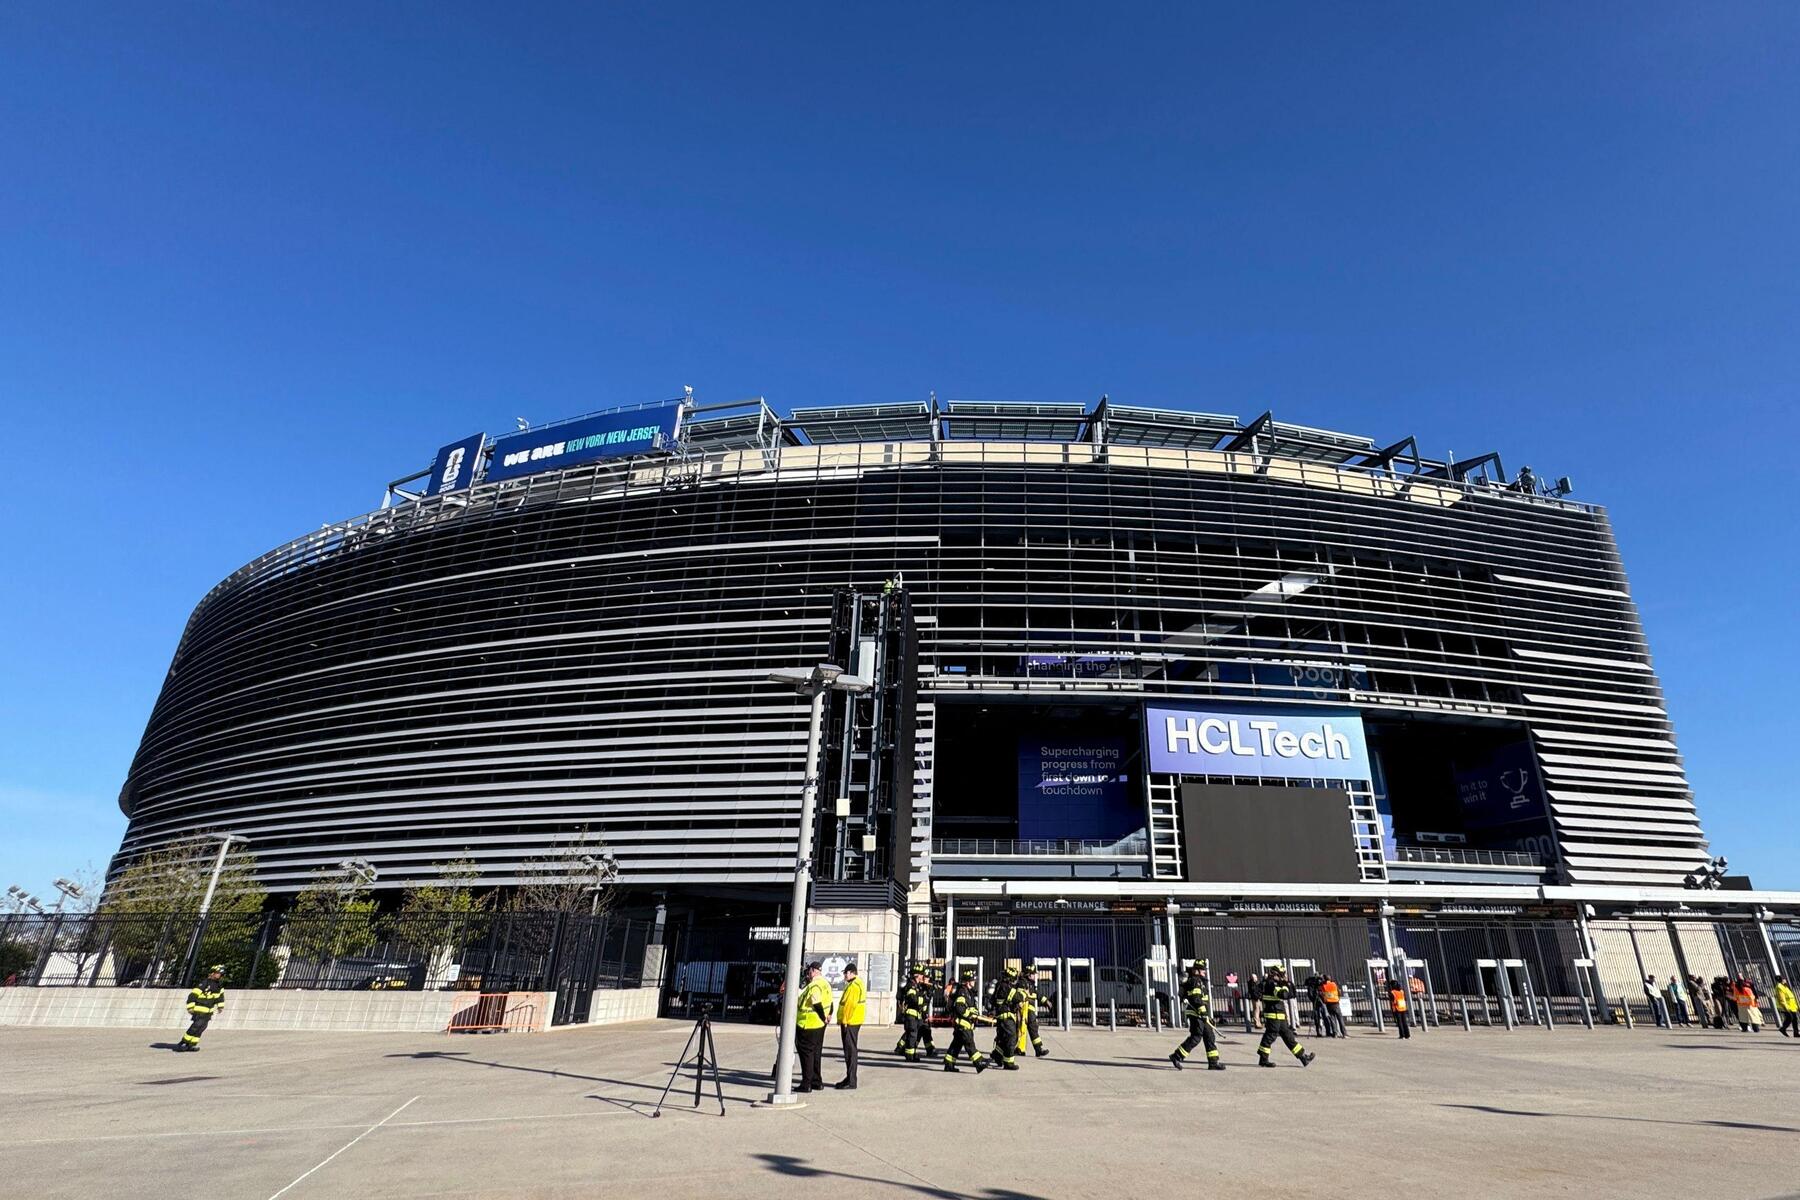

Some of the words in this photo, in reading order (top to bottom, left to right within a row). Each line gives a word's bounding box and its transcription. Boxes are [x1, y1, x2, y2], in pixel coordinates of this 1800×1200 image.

[503, 450, 530, 467] WE
[531, 441, 566, 460] ARE
[566, 438, 586, 454] NEW
[585, 433, 607, 449] YORK
[606, 430, 628, 445] NEW
[627, 425, 661, 442] JERSEY
[1086, 659, 1107, 671] the
[1166, 716, 1350, 760] HCLTech
[1041, 746, 1119, 758] Supercharging
[1041, 761, 1088, 771] progress
[1090, 760, 1116, 769] from
[1041, 772, 1064, 782] first
[1065, 772, 1096, 782] down
[1042, 785, 1103, 795] touchdown
[1015, 901, 1058, 909] EMPLOYEE
[1233, 903, 1274, 911] GENERAL
[1275, 903, 1321, 911] ADMISSION
[1442, 905, 1480, 913] GENERAL
[1481, 905, 1523, 913] ADMISSION
